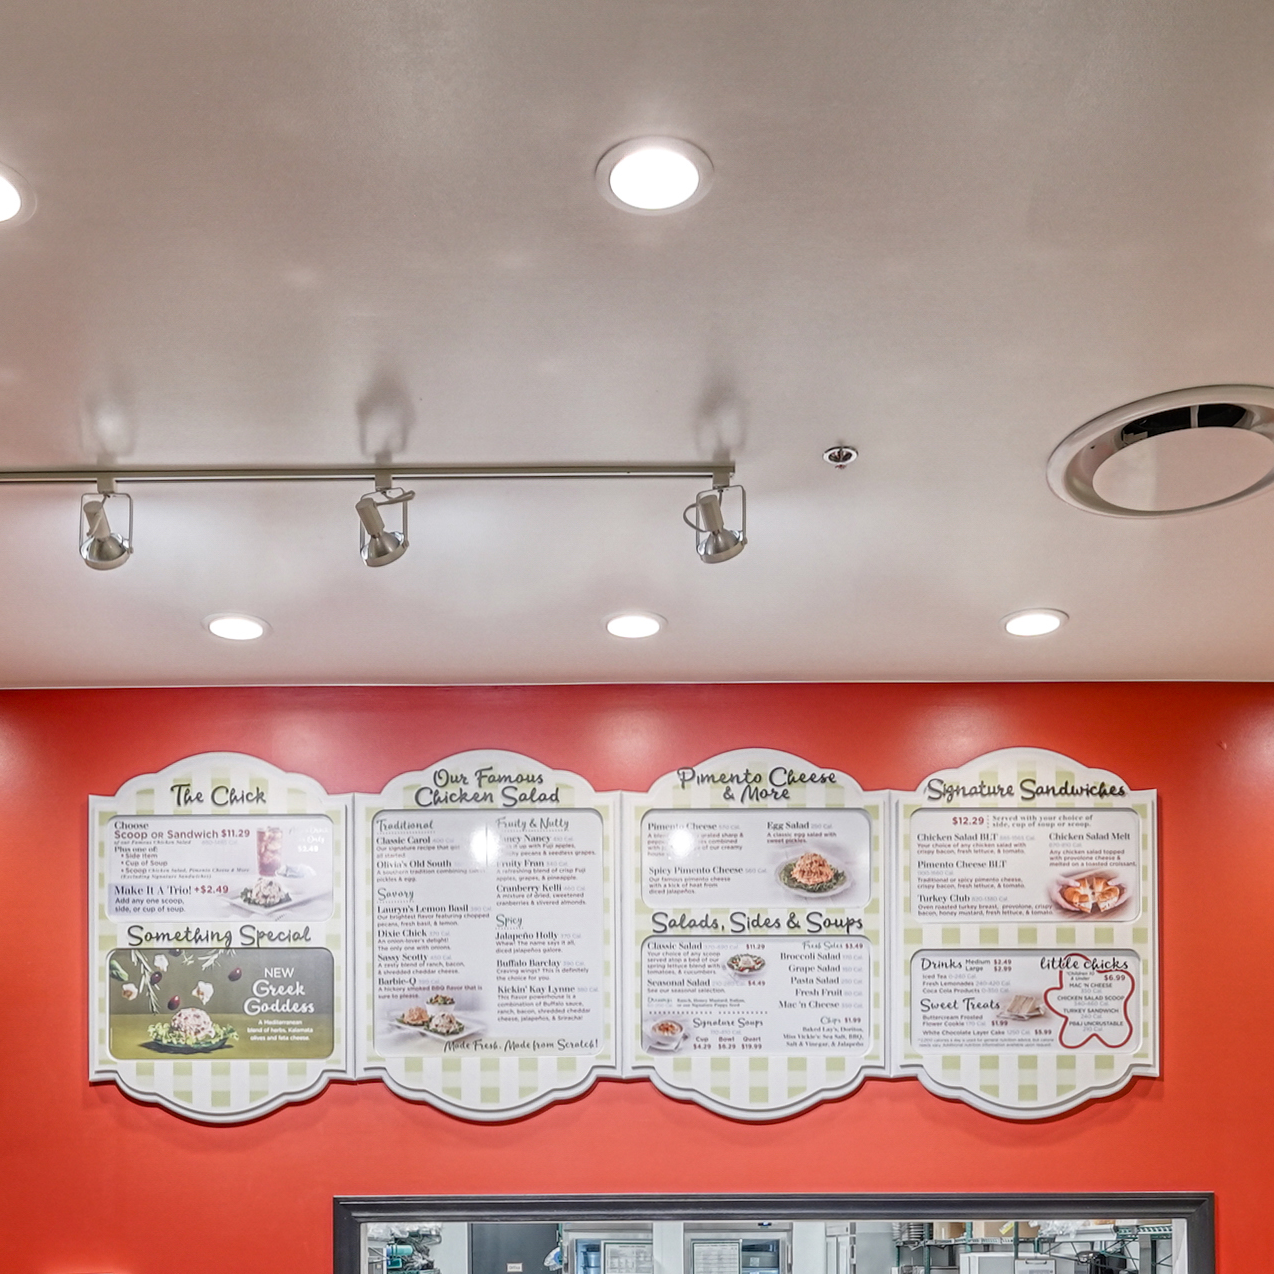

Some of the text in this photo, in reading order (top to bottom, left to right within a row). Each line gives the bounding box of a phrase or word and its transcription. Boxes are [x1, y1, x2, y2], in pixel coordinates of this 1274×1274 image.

[433, 767, 543, 787] Our Famous
[677, 767, 836, 787] Pimento Cheese
[170, 783, 267, 807] The Chick
[723, 785, 790, 803] & More
[927, 779, 1126, 802] Signature Sandwiches
[415, 786, 560, 807] Chicken Salad
[114, 821, 149, 830] Choose
[377, 819, 434, 831] Traditional
[767, 821, 809, 831] Egg Salad
[952, 817, 984, 825] $12.29
[114, 829, 250, 840] Scoop OR Sandwich $11.29
[1111, 832, 1130, 840] Melt
[114, 885, 228, 895] Make It A Trio! +$2.49
[378, 888, 414, 901] Savory
[496, 884, 562, 895] Cranberry Kelli
[917, 895, 947, 903] Turkey
[377, 905, 468, 914] Lauryn's Lemon Basil
[496, 914, 523, 927] Spicy
[652, 912, 863, 934] Salads, Sides & Soups
[127, 925, 311, 947] Something Special
[536, 932, 558, 940] Holly
[648, 942, 676, 950] Classic
[678, 942, 702, 950] Salad
[780, 952, 840, 961] Broccoli Salad
[788, 964, 840, 974] Grape Salad
[921, 958, 962, 970] Drinks
[1040, 957, 1128, 971] little chicks
[264, 968, 294, 978] NEW
[253, 980, 305, 997] Greek
[530, 986, 546, 995] Kay
[548, 986, 575, 994] Lynne
[795, 988, 842, 997] Fresh Fruit
[244, 998, 314, 1015] Goddess
[920, 997, 1000, 1012] Sweet Treats
[693, 1018, 763, 1029] Signature Soups
